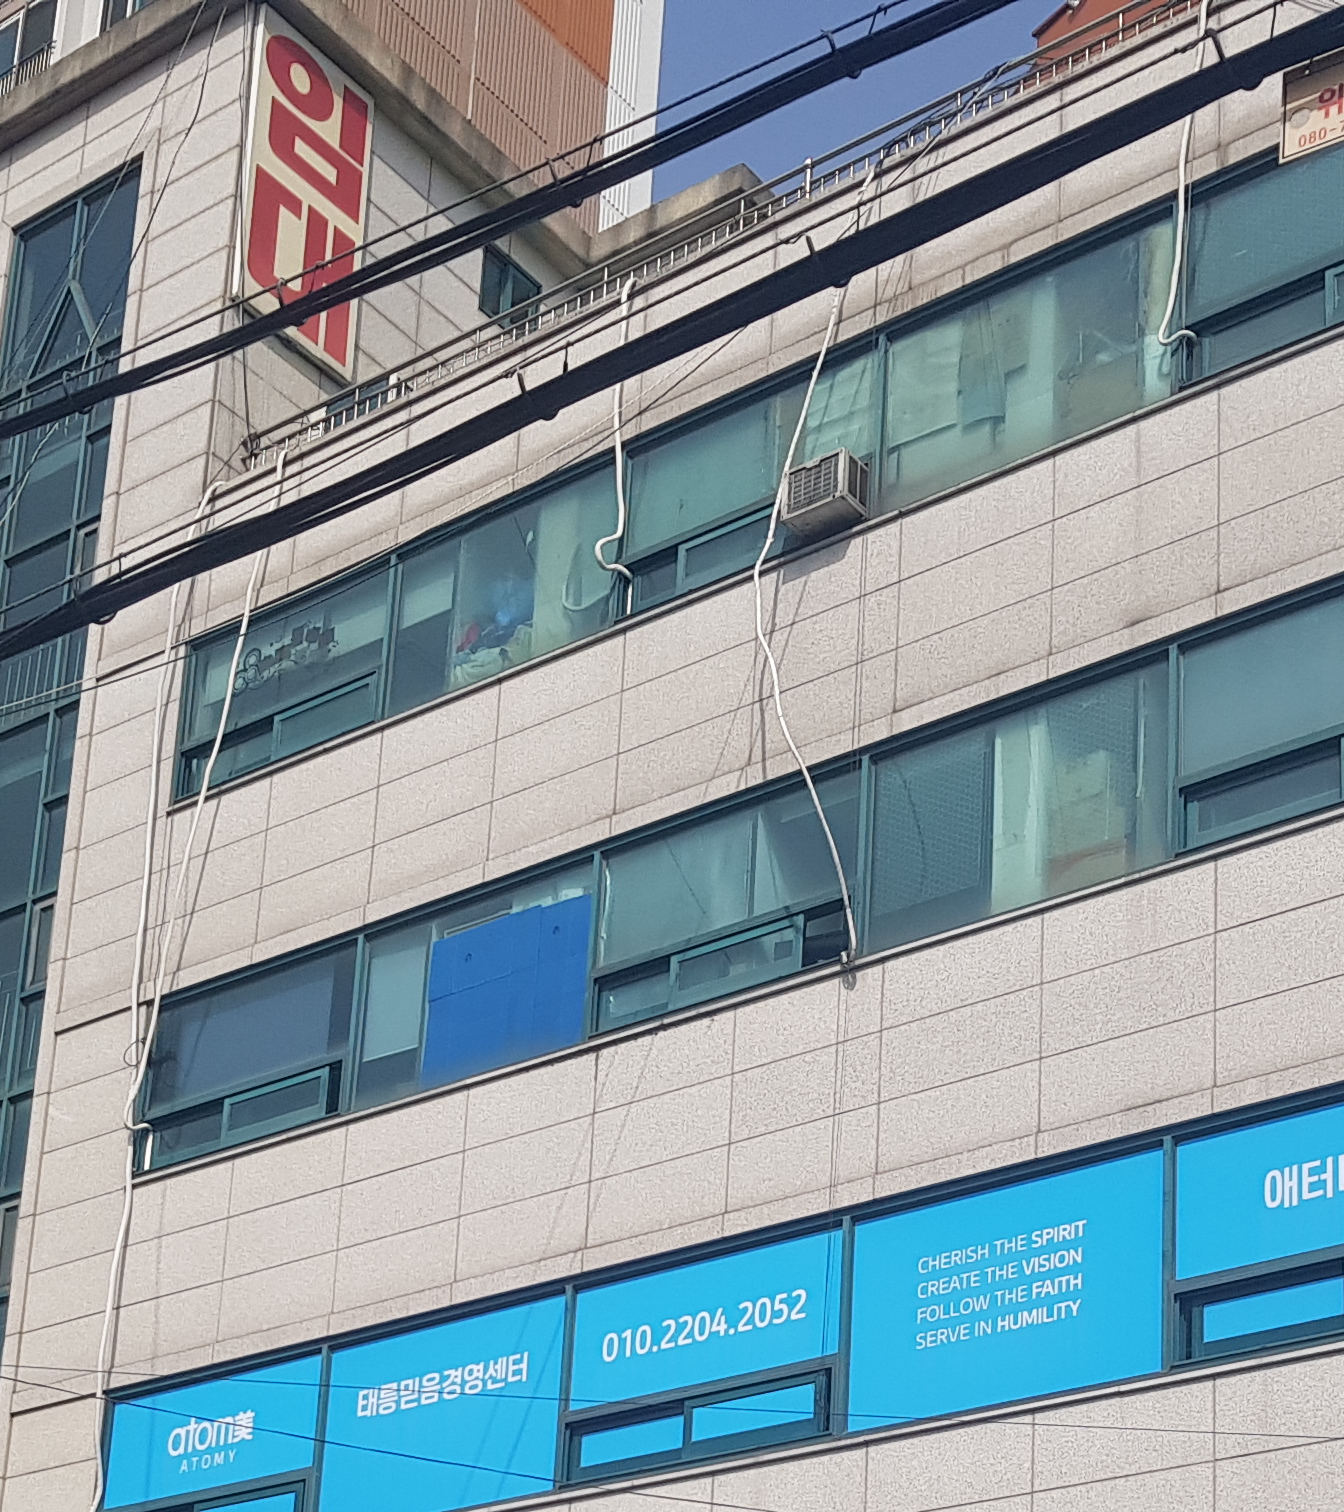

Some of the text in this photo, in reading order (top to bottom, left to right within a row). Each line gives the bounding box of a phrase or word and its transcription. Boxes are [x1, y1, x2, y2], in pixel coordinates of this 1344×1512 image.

[918, 1219, 1087, 1274] CHERISH THE SPIRIT
[916, 1273, 1083, 1325] FOLLOW THE FAITH
[917, 1247, 1083, 1299] CREATE THE VISION
[602, 1289, 808, 1363] 010.2204.2052
[915, 1299, 1081, 1350] SERVE IN HUMILITY
[178, 1448, 237, 1475] ATOMY
